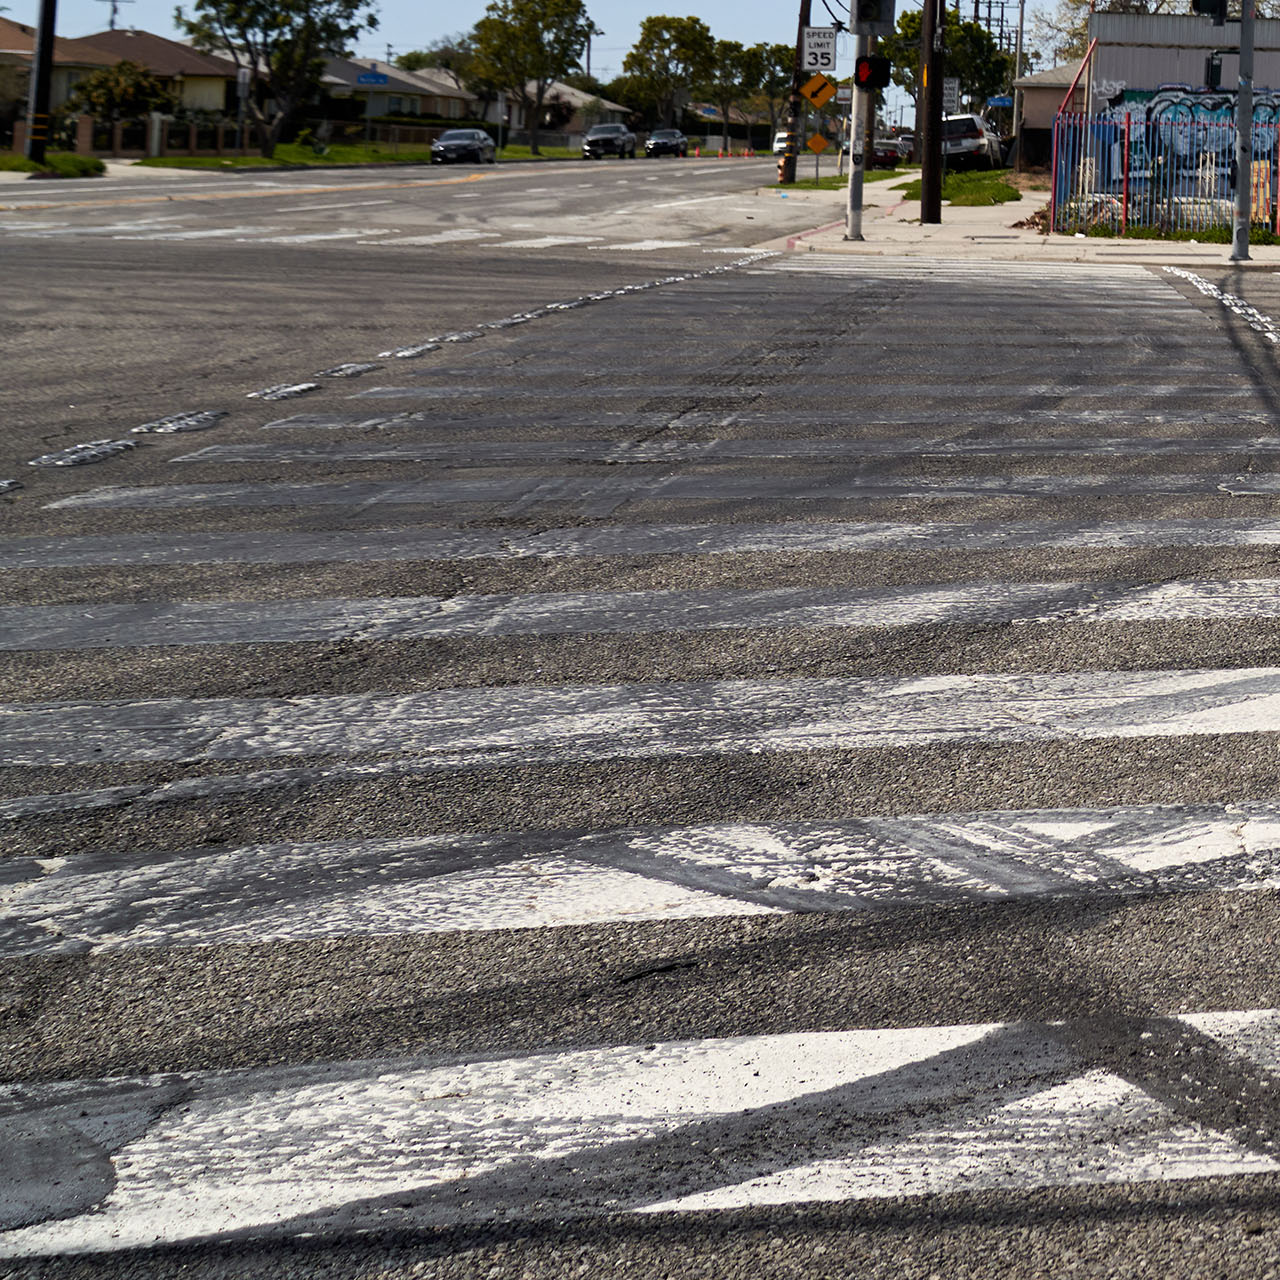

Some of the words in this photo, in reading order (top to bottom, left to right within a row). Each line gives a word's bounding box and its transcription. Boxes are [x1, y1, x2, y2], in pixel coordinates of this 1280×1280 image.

[806, 31, 835, 40] SPEED
[808, 41, 832, 49] LIMIT
[807, 51, 832, 67] 35
